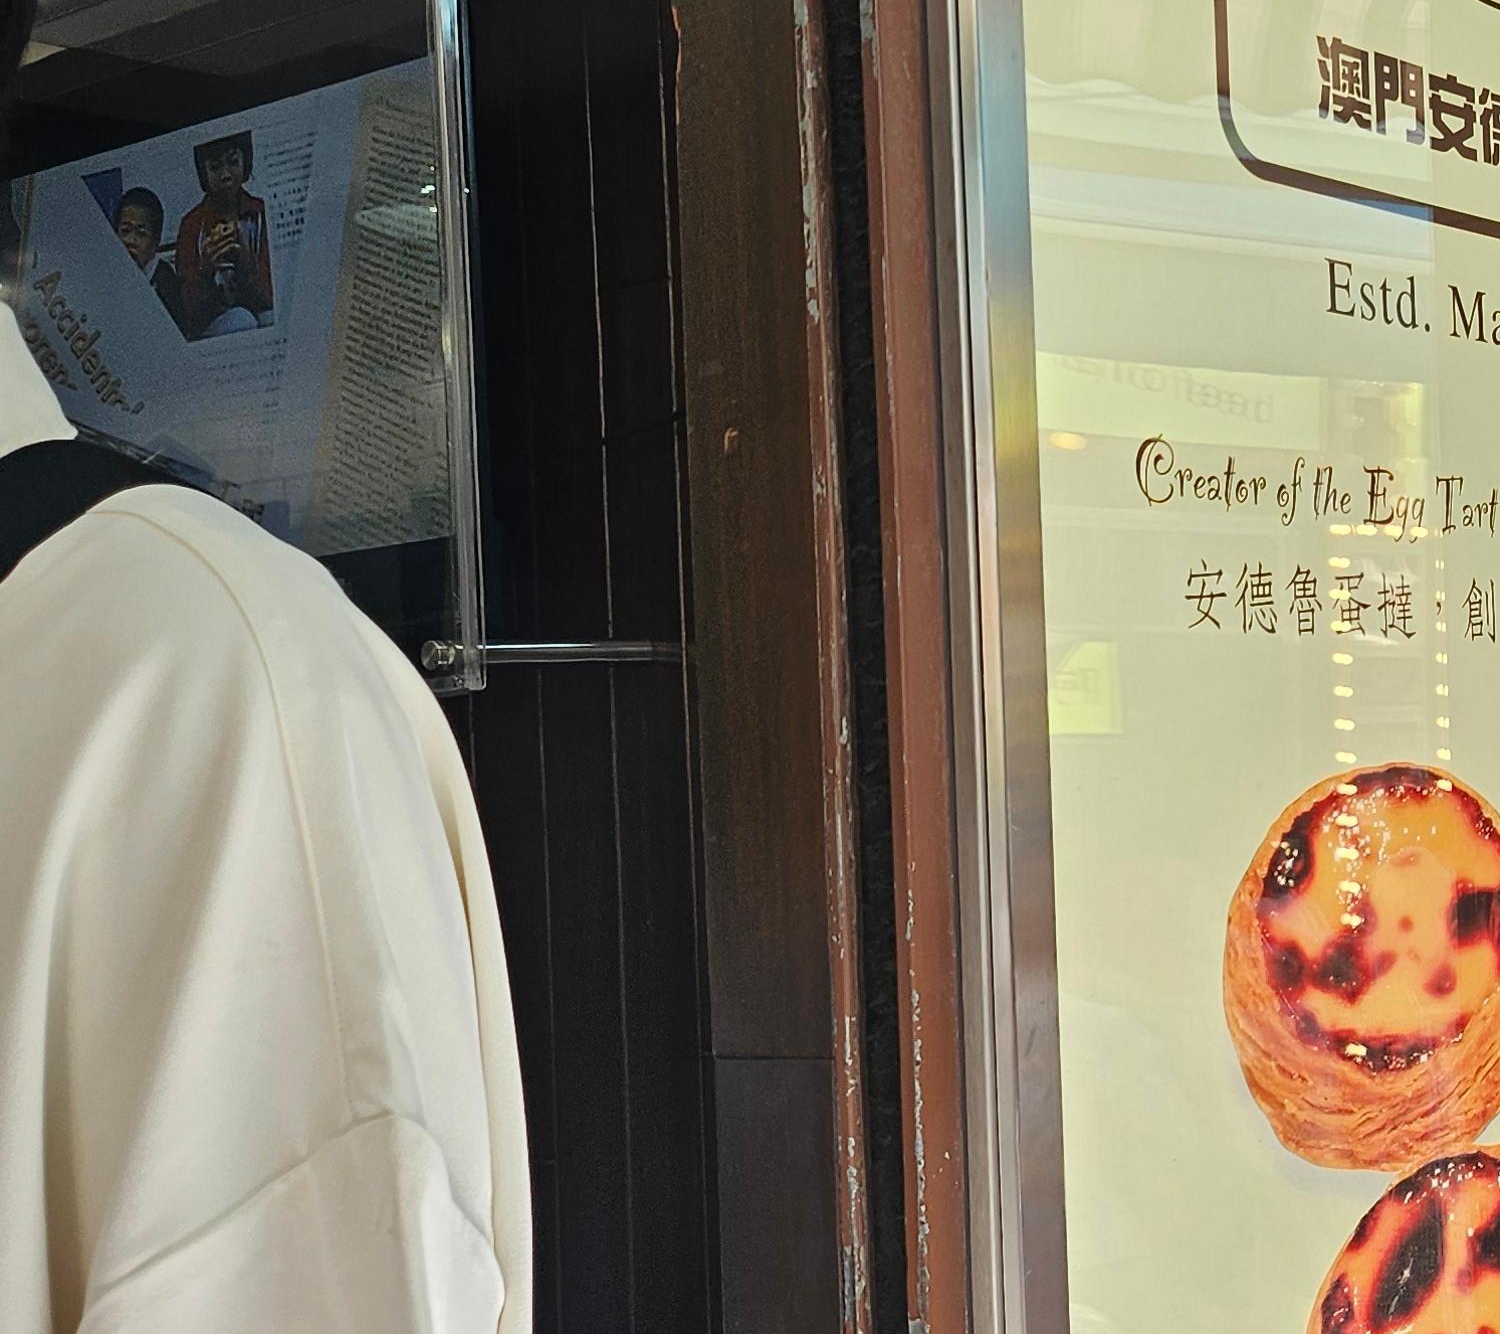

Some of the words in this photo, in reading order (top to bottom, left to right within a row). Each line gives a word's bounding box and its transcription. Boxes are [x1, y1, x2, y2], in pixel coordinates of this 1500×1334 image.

[1324, 256, 1432, 334] Estd.
[1135, 433, 1269, 513] Creator
[1276, 456, 1306, 527] of
[1312, 465, 1352, 521] the
[1362, 465, 1426, 544] Egg
[1435, 474, 1500, 538] Tart
